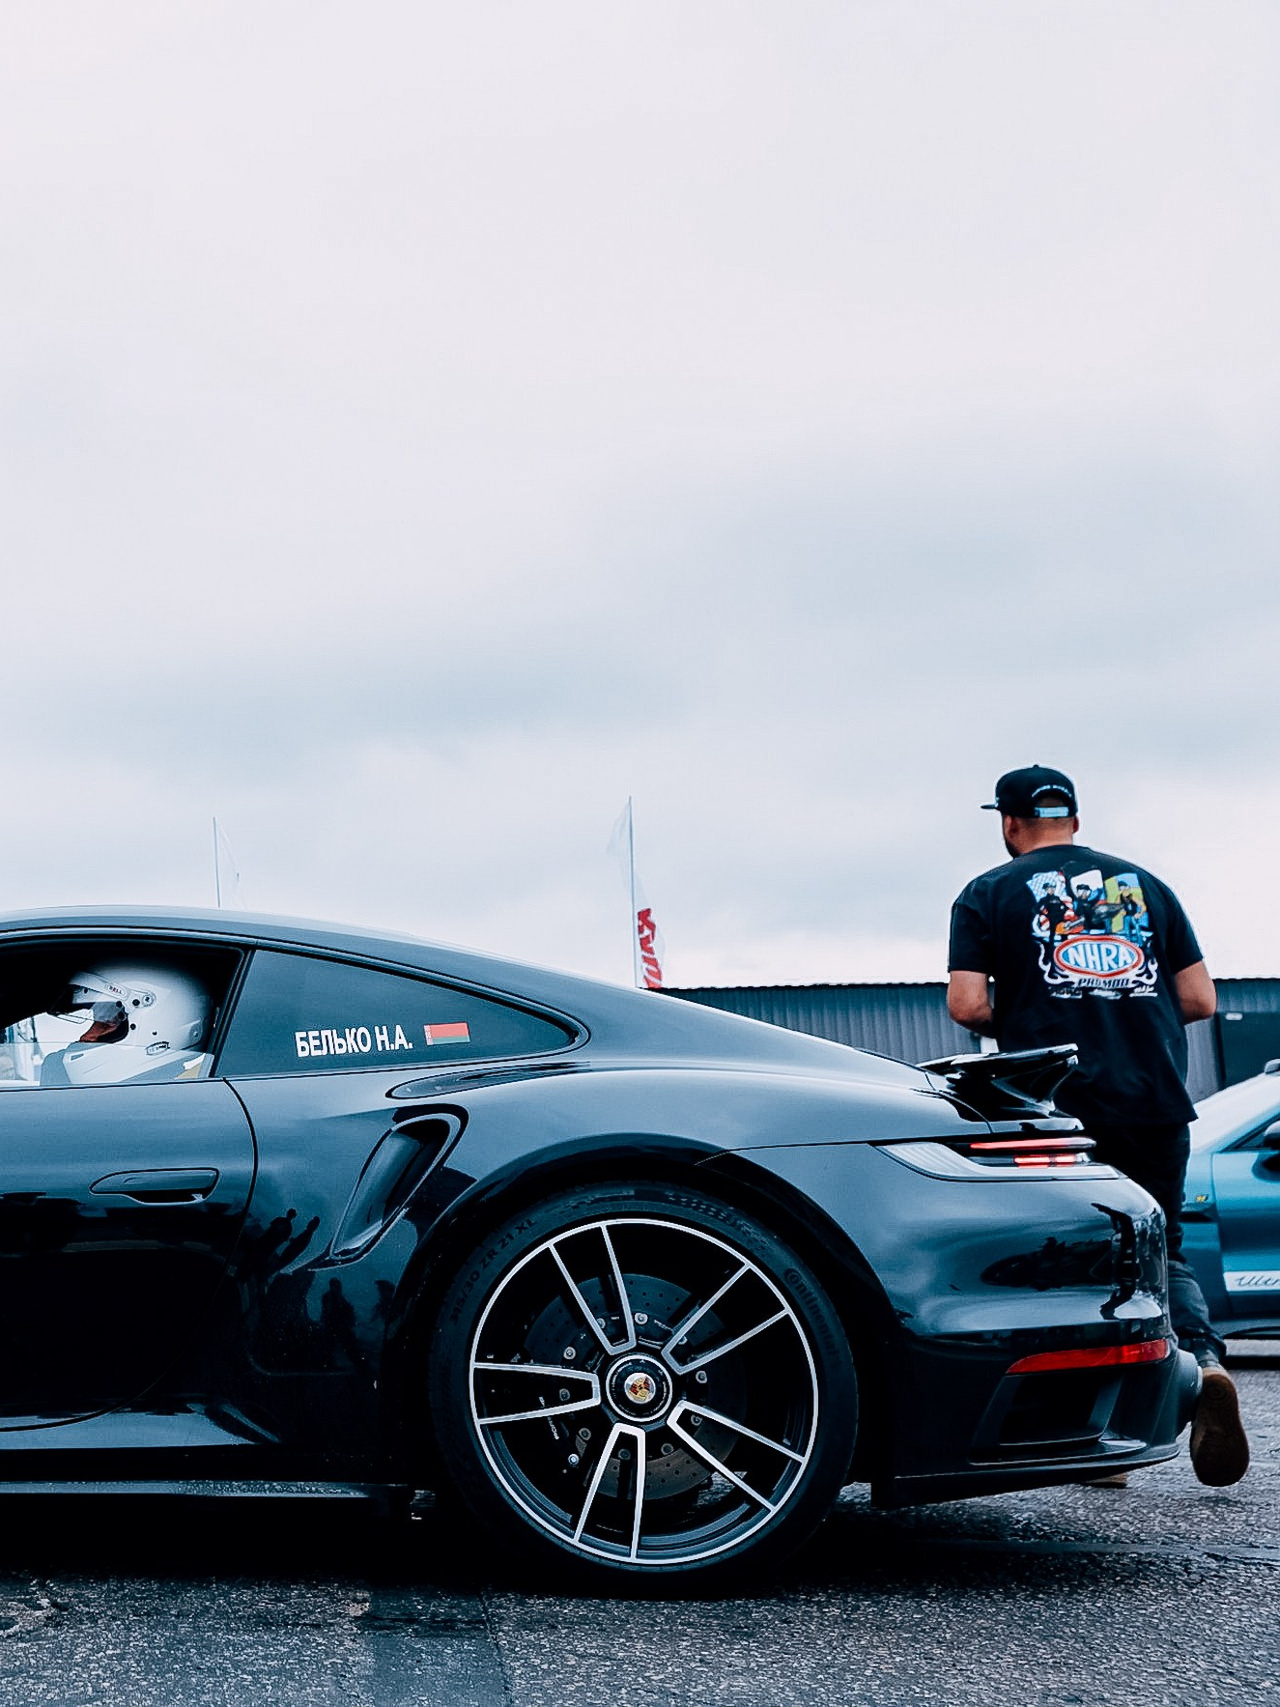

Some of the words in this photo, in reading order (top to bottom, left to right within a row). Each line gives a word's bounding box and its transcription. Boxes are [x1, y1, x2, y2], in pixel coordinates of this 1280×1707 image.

[1067, 943, 1134, 971] NHRA
[295, 1026, 372, 1057] БЕЛЬКО
[374, 1024, 414, 1052] Н.А.
